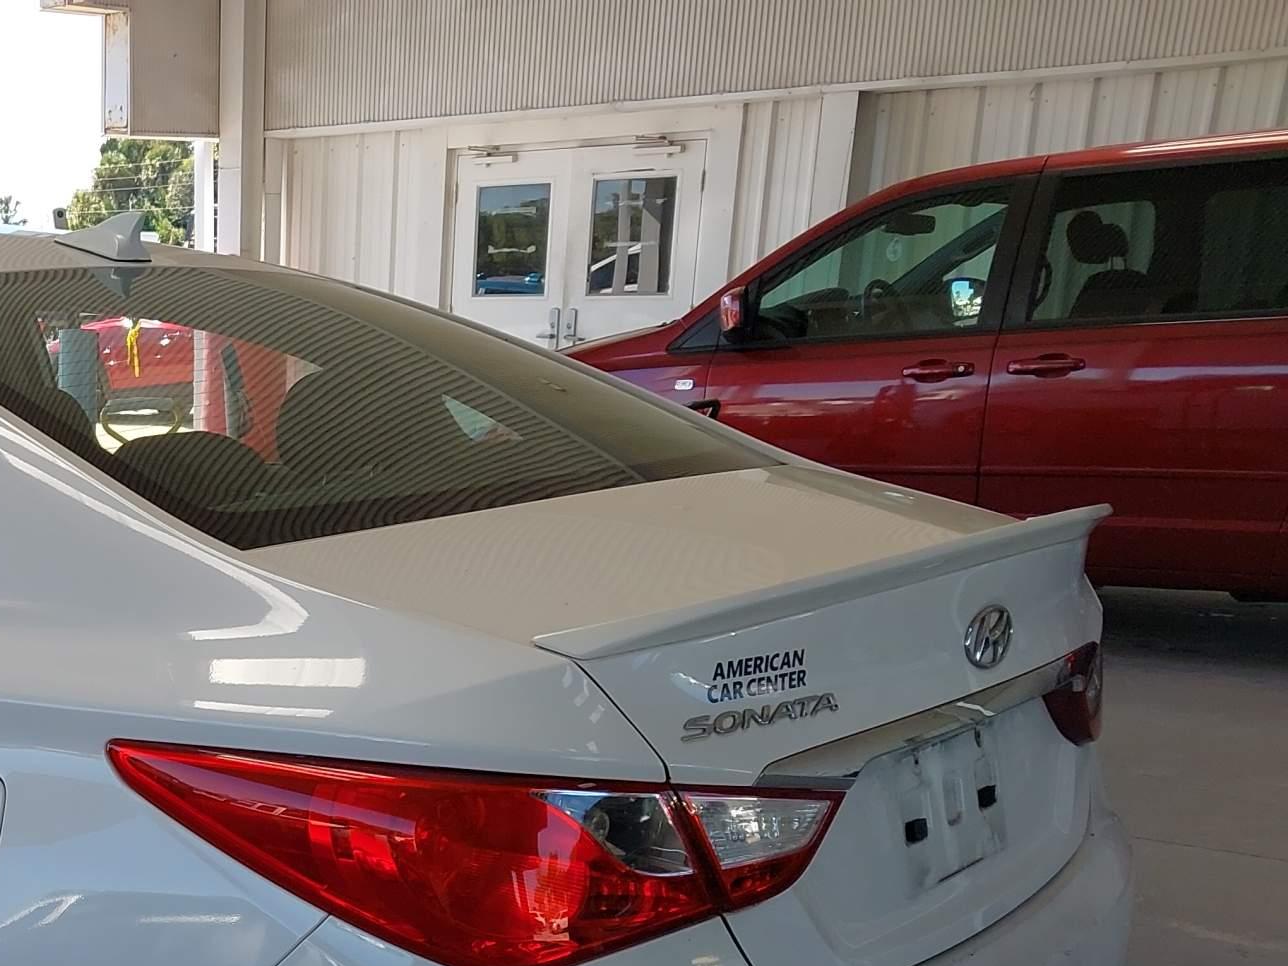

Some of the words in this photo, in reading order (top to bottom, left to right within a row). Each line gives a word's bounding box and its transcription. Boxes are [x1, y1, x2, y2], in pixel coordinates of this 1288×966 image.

[712, 648, 806, 682] AMERICAN
[707, 681, 745, 704] CAR
[746, 669, 807, 697] CENTER
[680, 692, 840, 742] SONATA
